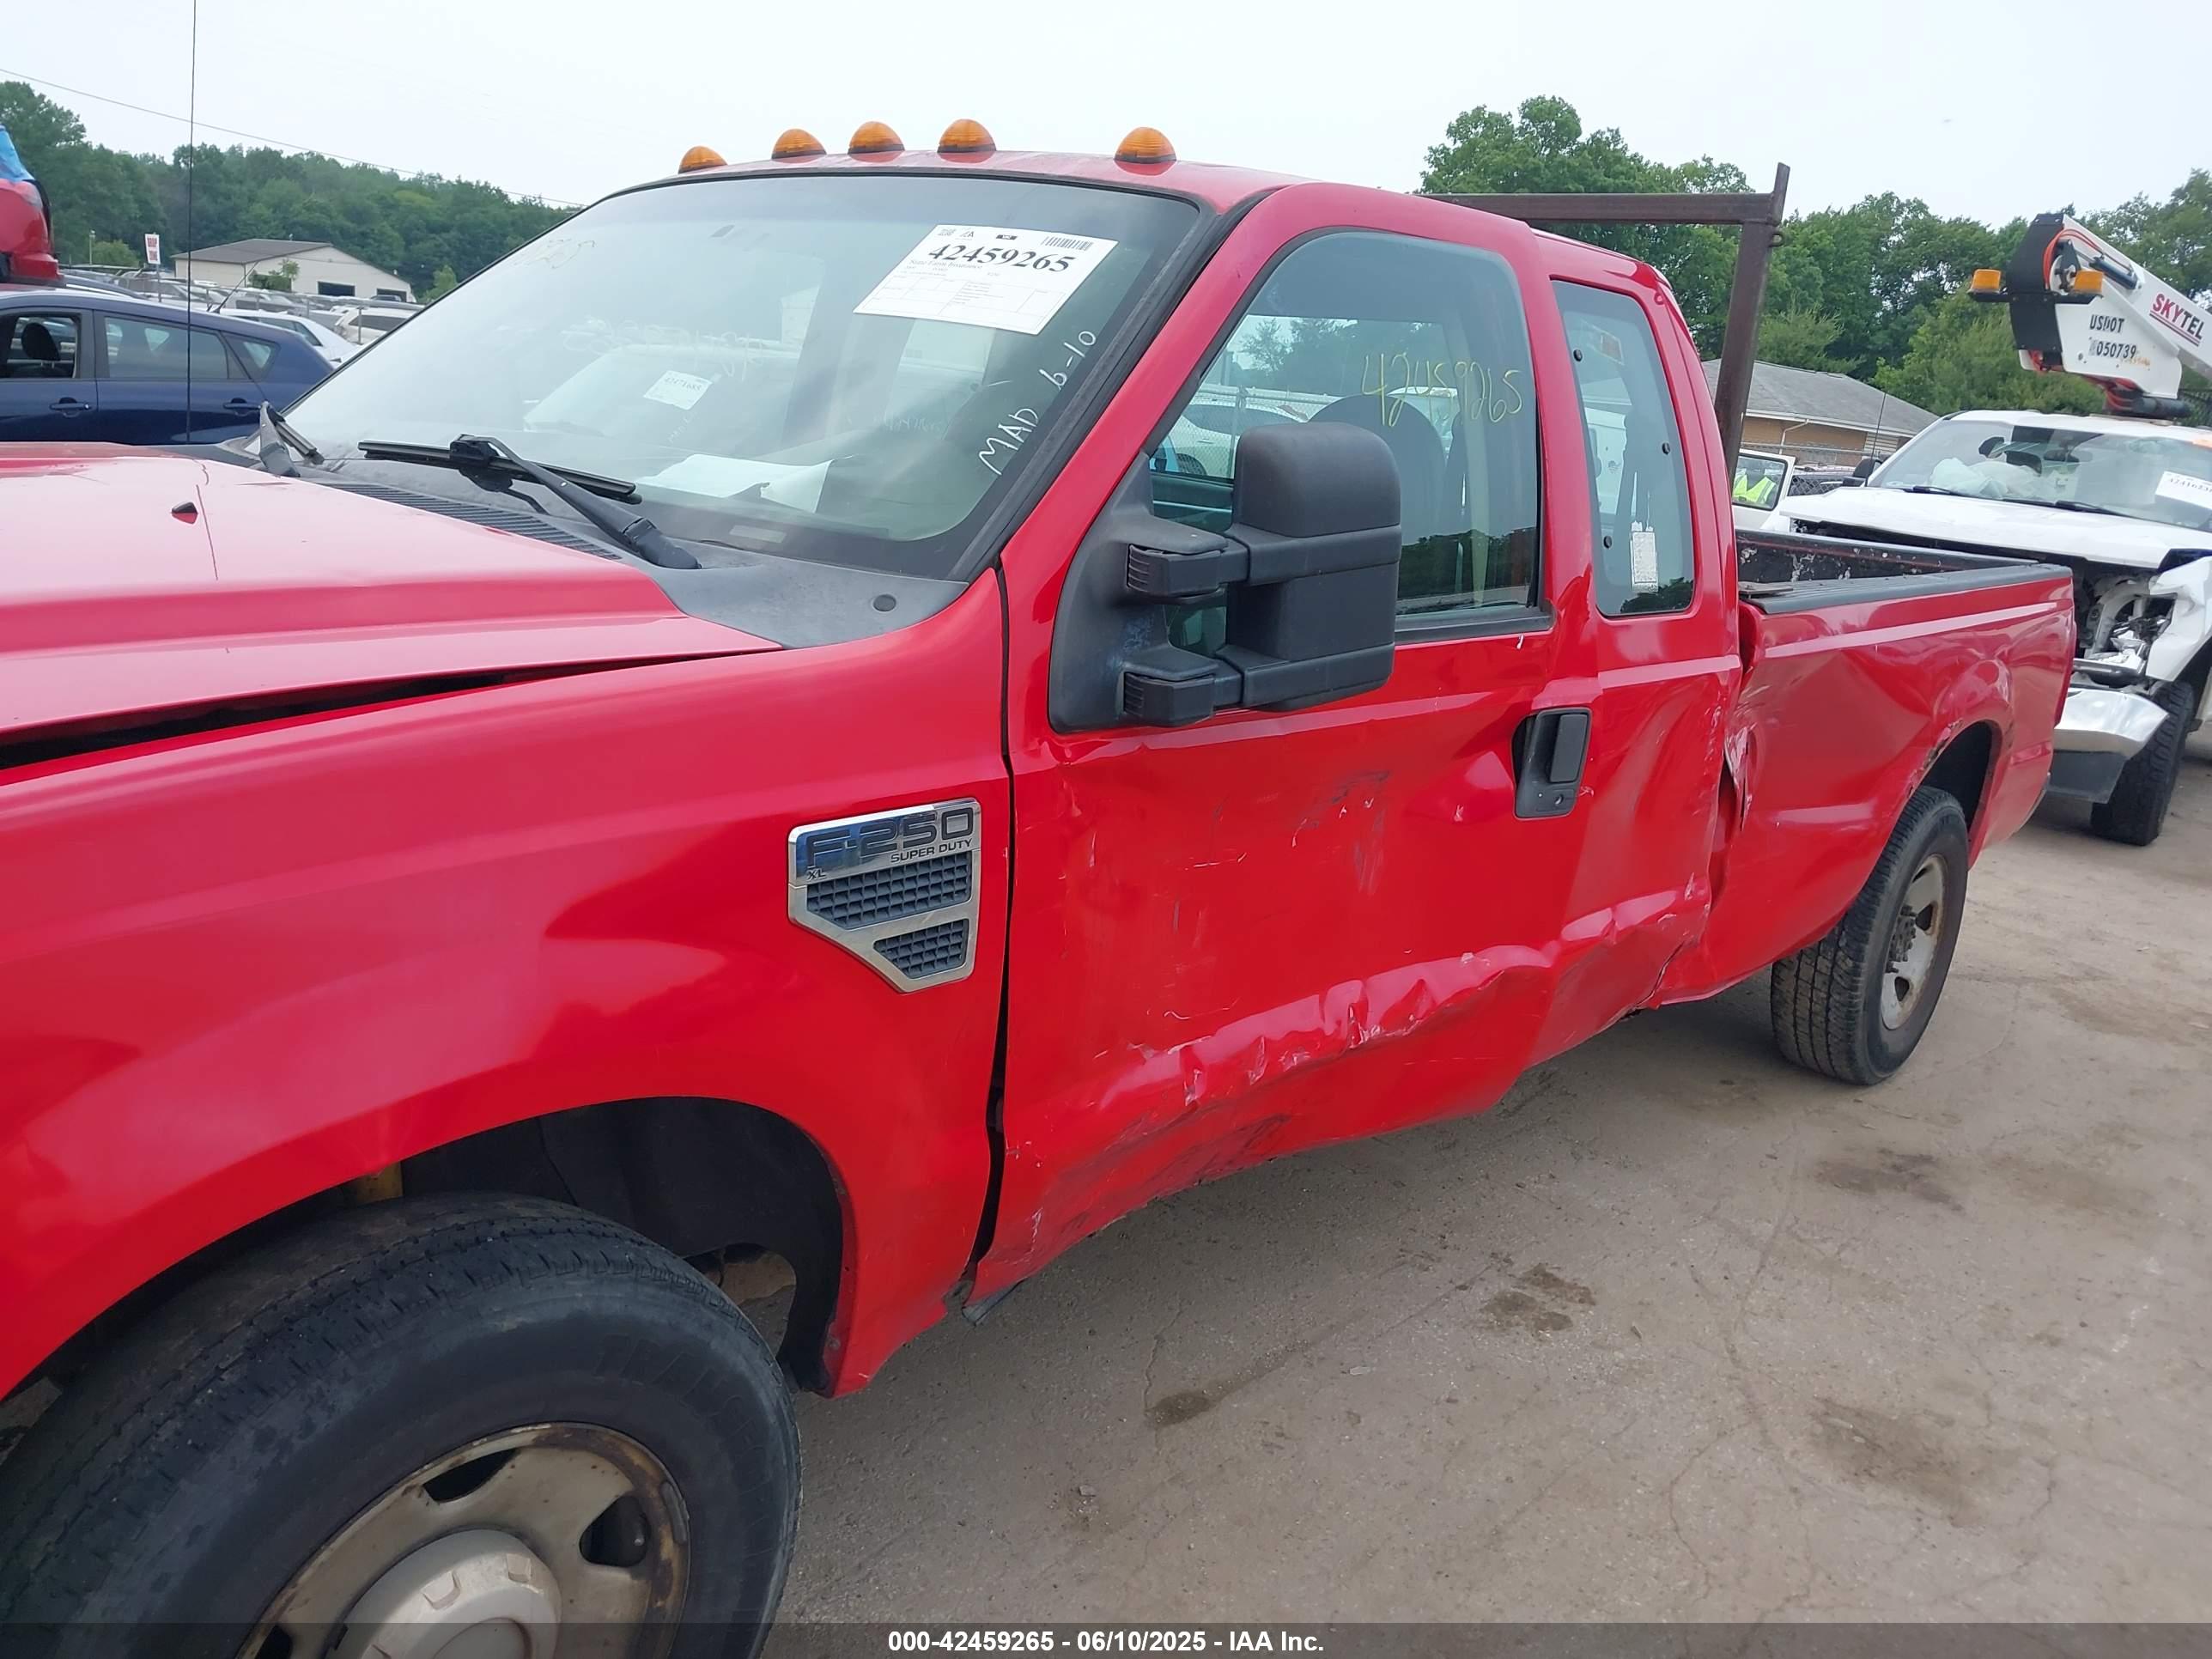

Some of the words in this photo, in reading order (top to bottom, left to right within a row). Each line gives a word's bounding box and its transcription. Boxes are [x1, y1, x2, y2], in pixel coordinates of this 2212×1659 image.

[928, 243, 1076, 272] 42459265
[2089, 314, 2125, 333] USDOT
[2153, 294, 2204, 340] SKYTEL
[2089, 340, 2136, 359] 050739
[978, 408, 1039, 476] MAD
[805, 807, 974, 868] F-250
[890, 846, 935, 863] SUPER
[939, 838, 973, 853] DUTY
[806, 869, 827, 881] XL
